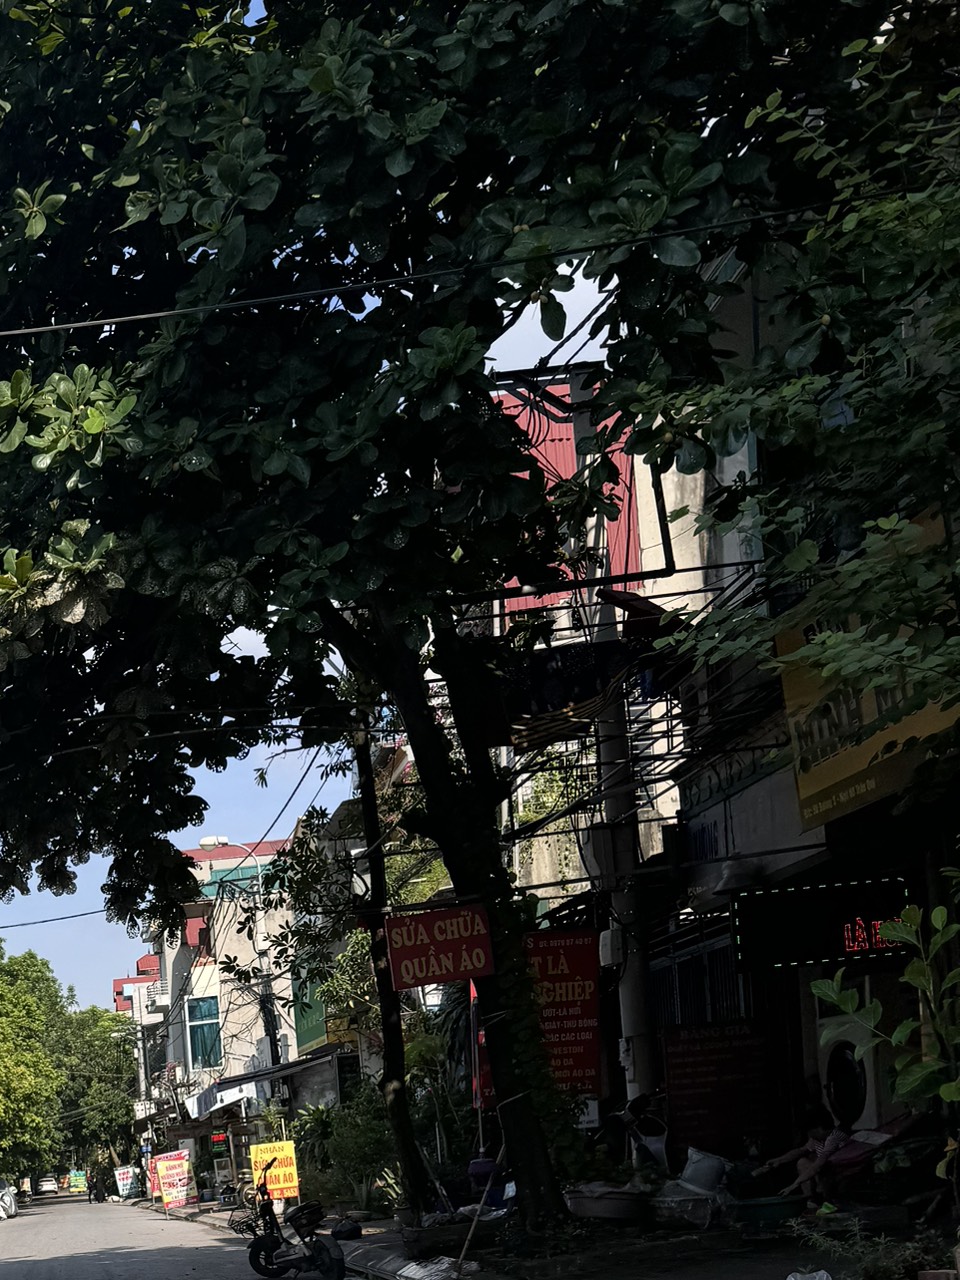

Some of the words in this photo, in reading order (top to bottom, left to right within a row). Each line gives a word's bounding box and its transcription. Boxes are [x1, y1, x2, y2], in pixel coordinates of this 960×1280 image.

[391, 918, 430, 948] SỬA
[434, 911, 487, 941] CHỮA
[400, 946, 454, 984] QUẦN
[459, 944, 486, 971] ÁO
